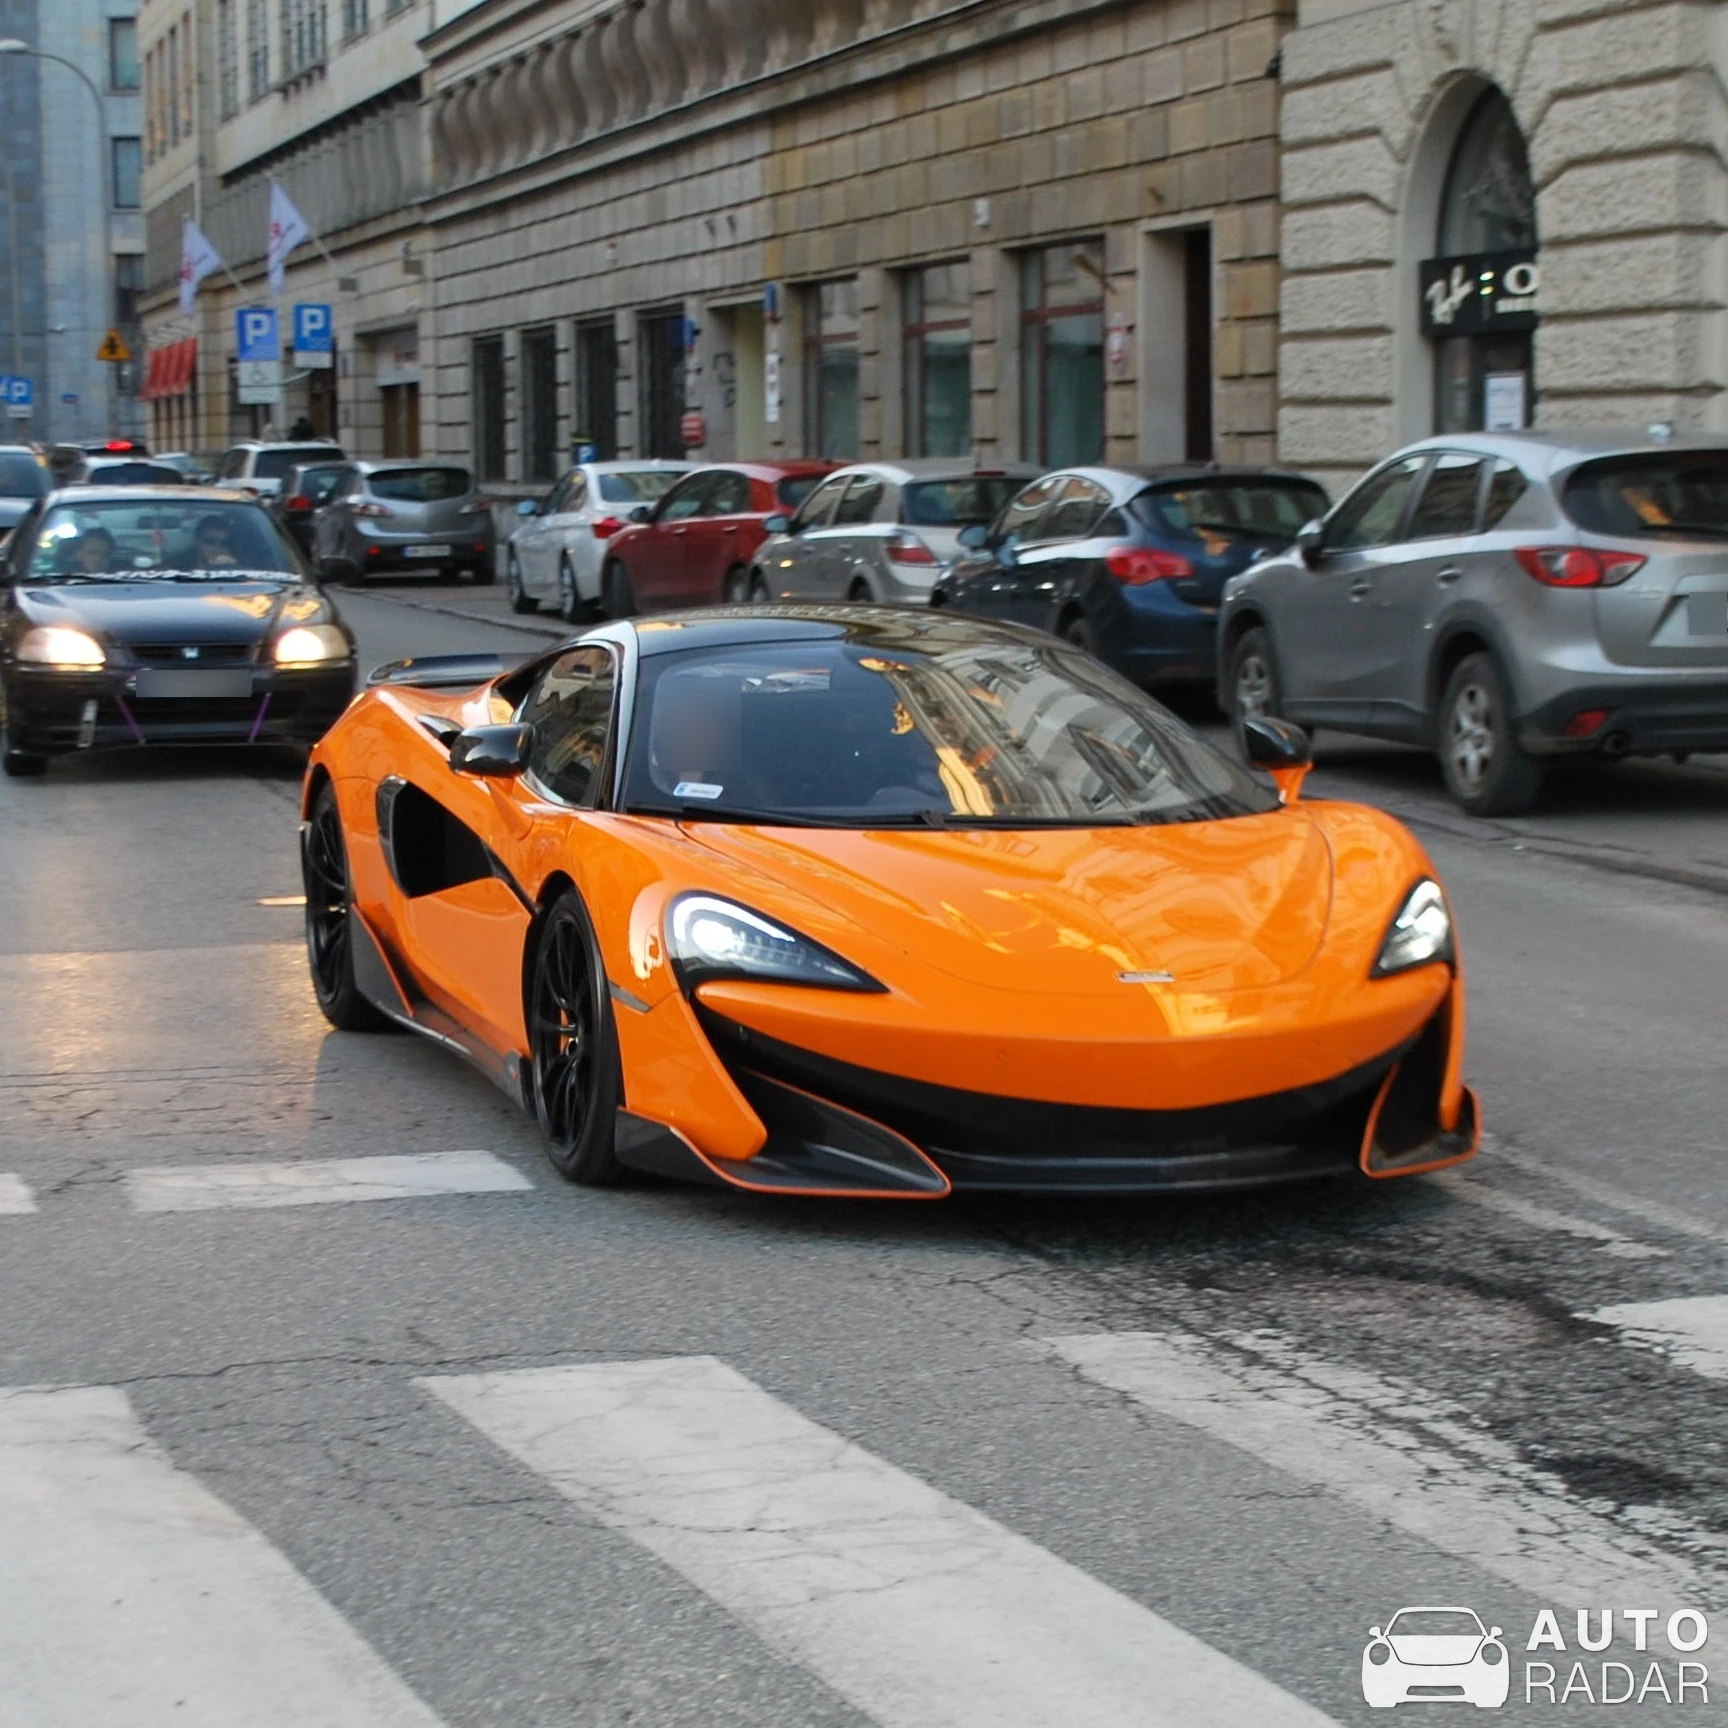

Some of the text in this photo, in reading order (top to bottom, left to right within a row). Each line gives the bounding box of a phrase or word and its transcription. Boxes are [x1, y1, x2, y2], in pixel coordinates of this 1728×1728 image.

[245, 313, 271, 346] P
[301, 308, 325, 338] P
[11, 381, 28, 404] P
